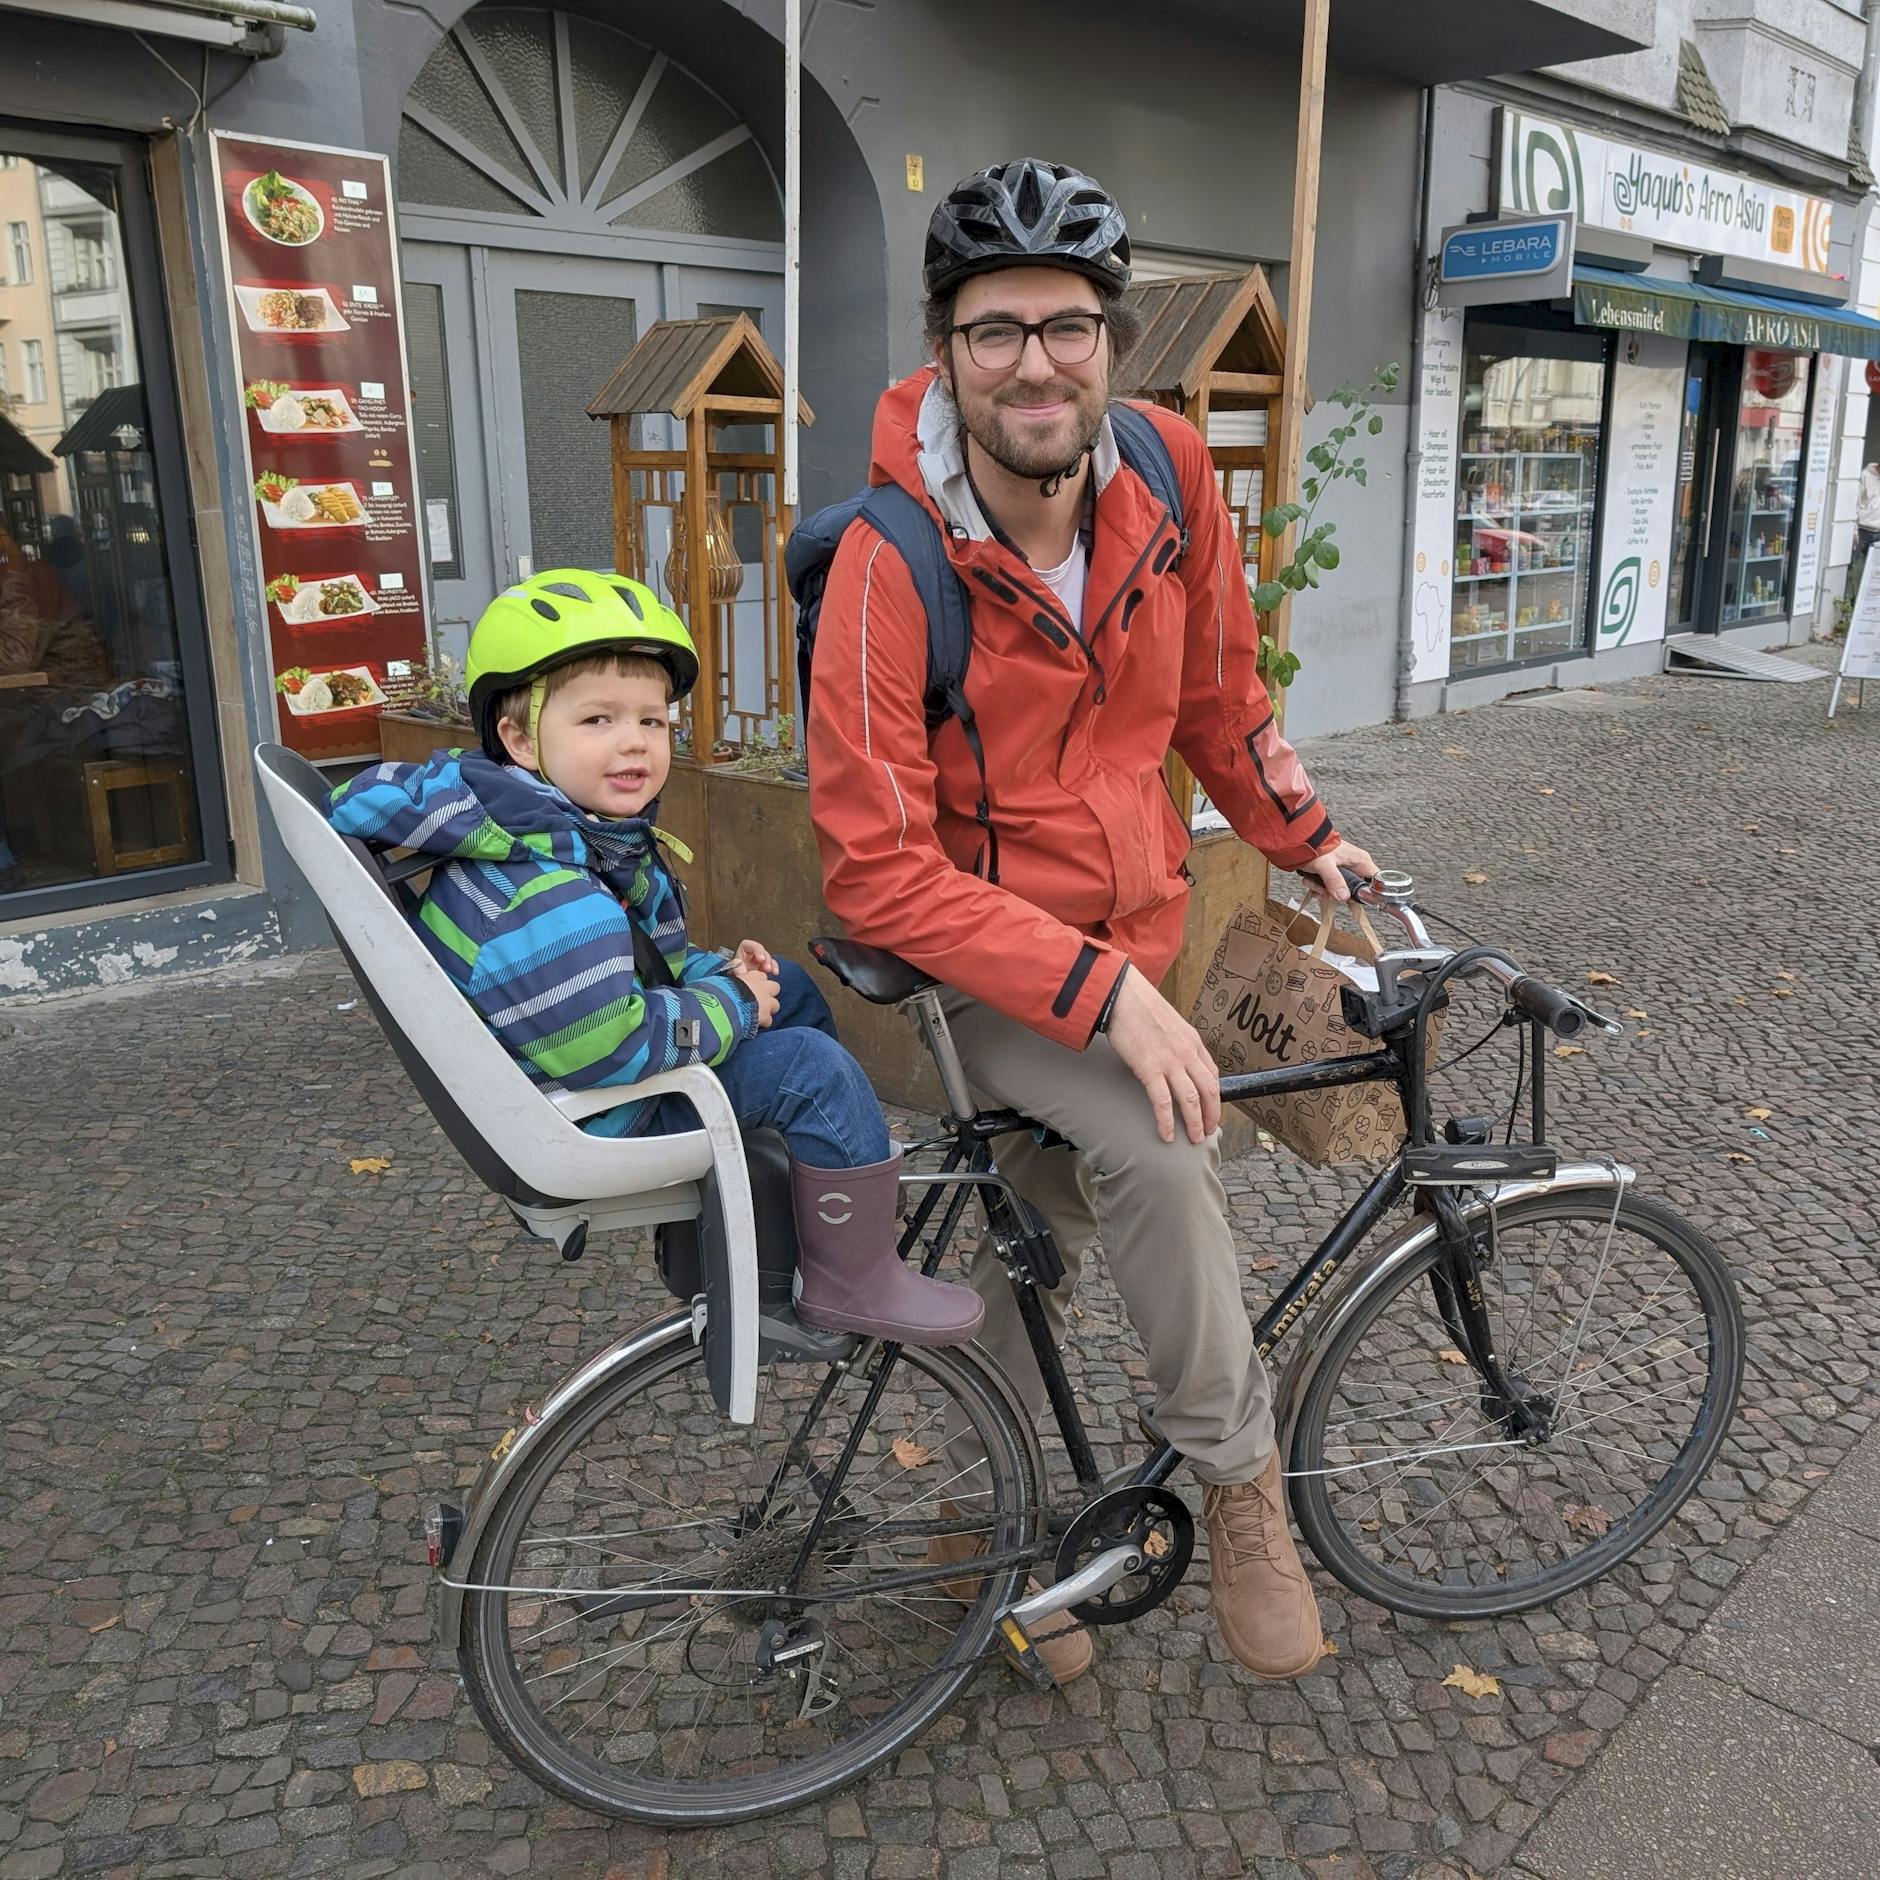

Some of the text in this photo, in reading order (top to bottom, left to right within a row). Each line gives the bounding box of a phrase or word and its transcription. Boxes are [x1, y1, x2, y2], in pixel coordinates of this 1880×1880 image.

[1614, 152, 1765, 234] Yaqub's Afro Asia
[1482, 236, 1552, 255] LEBARA
[1491, 250, 1550, 262] MOBILE
[1592, 299, 1664, 332] Lebensmittel
[1744, 314, 1820, 349] AFRO ASIA
[1227, 992, 1297, 1062] Wolt
[1272, 1259, 1336, 1338] miyata
[1010, 1428, 1033, 1504] CONTINENTAL
